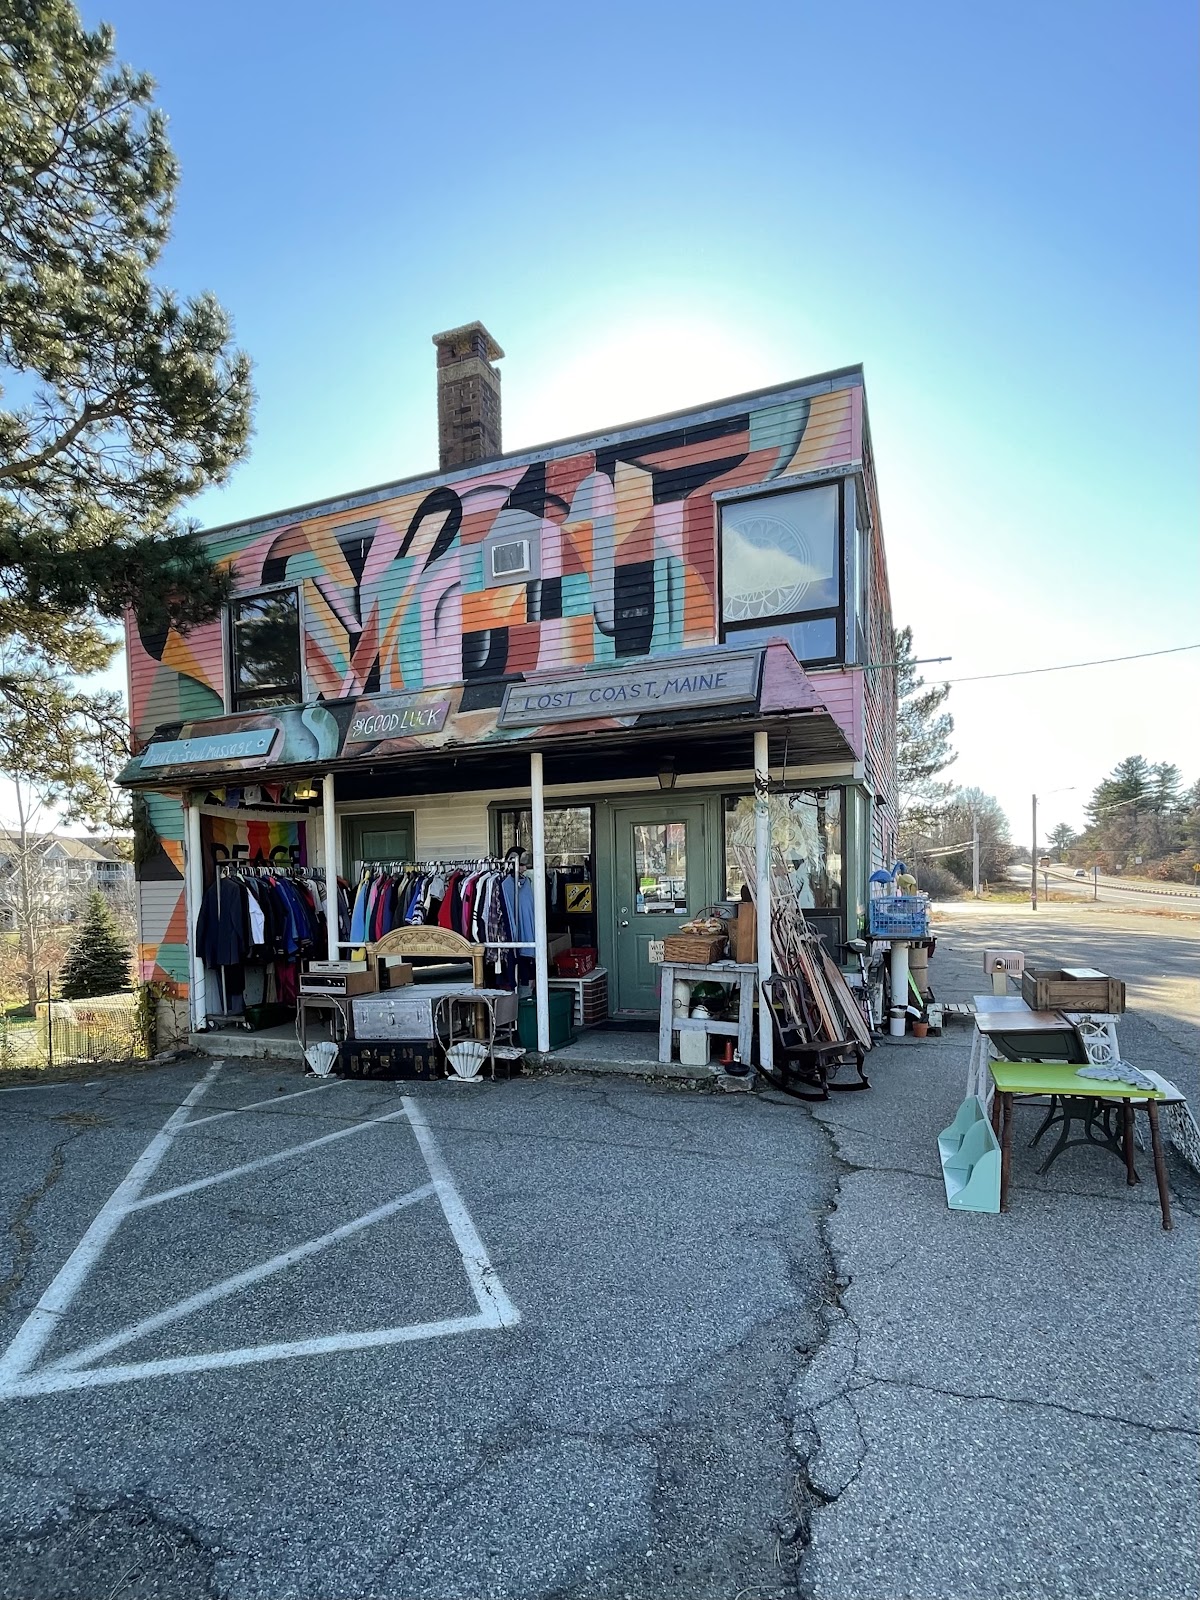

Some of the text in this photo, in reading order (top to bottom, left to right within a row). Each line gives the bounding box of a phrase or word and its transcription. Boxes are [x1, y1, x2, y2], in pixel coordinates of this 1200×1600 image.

[525, 691, 577, 710] LOST
[663, 672, 728, 695] MAINE
[364, 708, 442, 735] GOOD LUCK
[211, 843, 300, 868] PEACE
